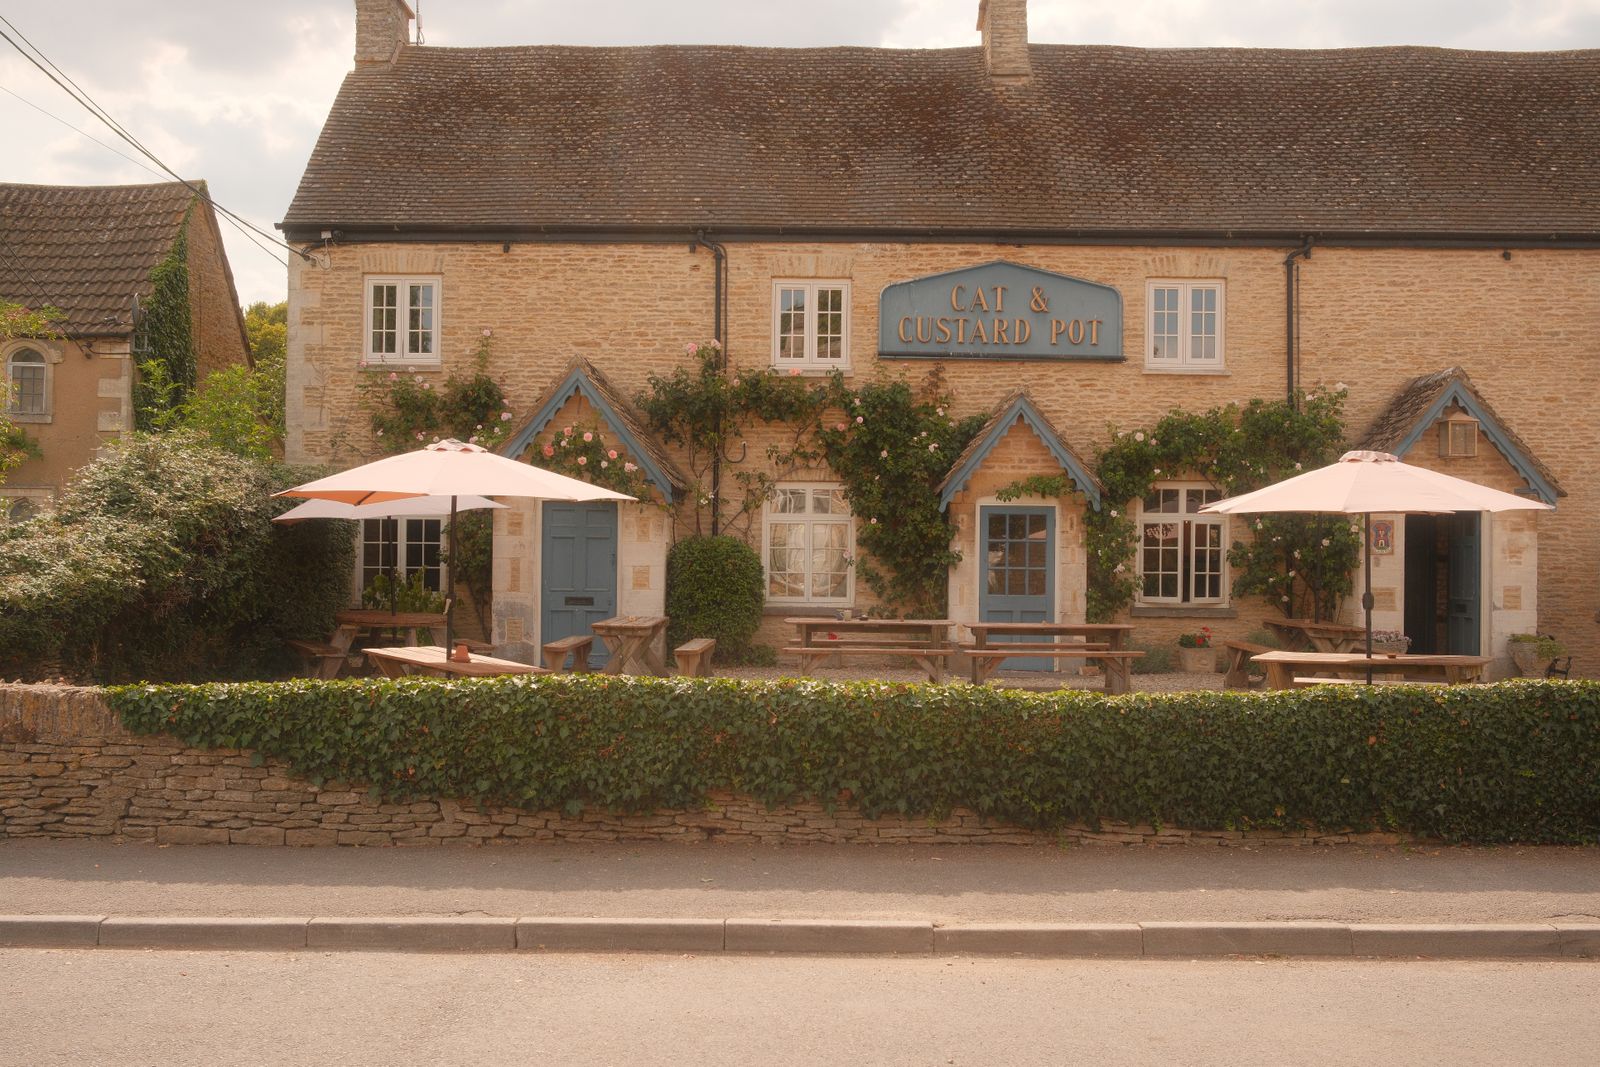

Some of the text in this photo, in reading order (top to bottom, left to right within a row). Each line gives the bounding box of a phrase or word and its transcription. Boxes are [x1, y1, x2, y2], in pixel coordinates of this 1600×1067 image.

[951, 285, 1050, 313] CAT &
[898, 316, 1103, 345] CUSTARD POT
